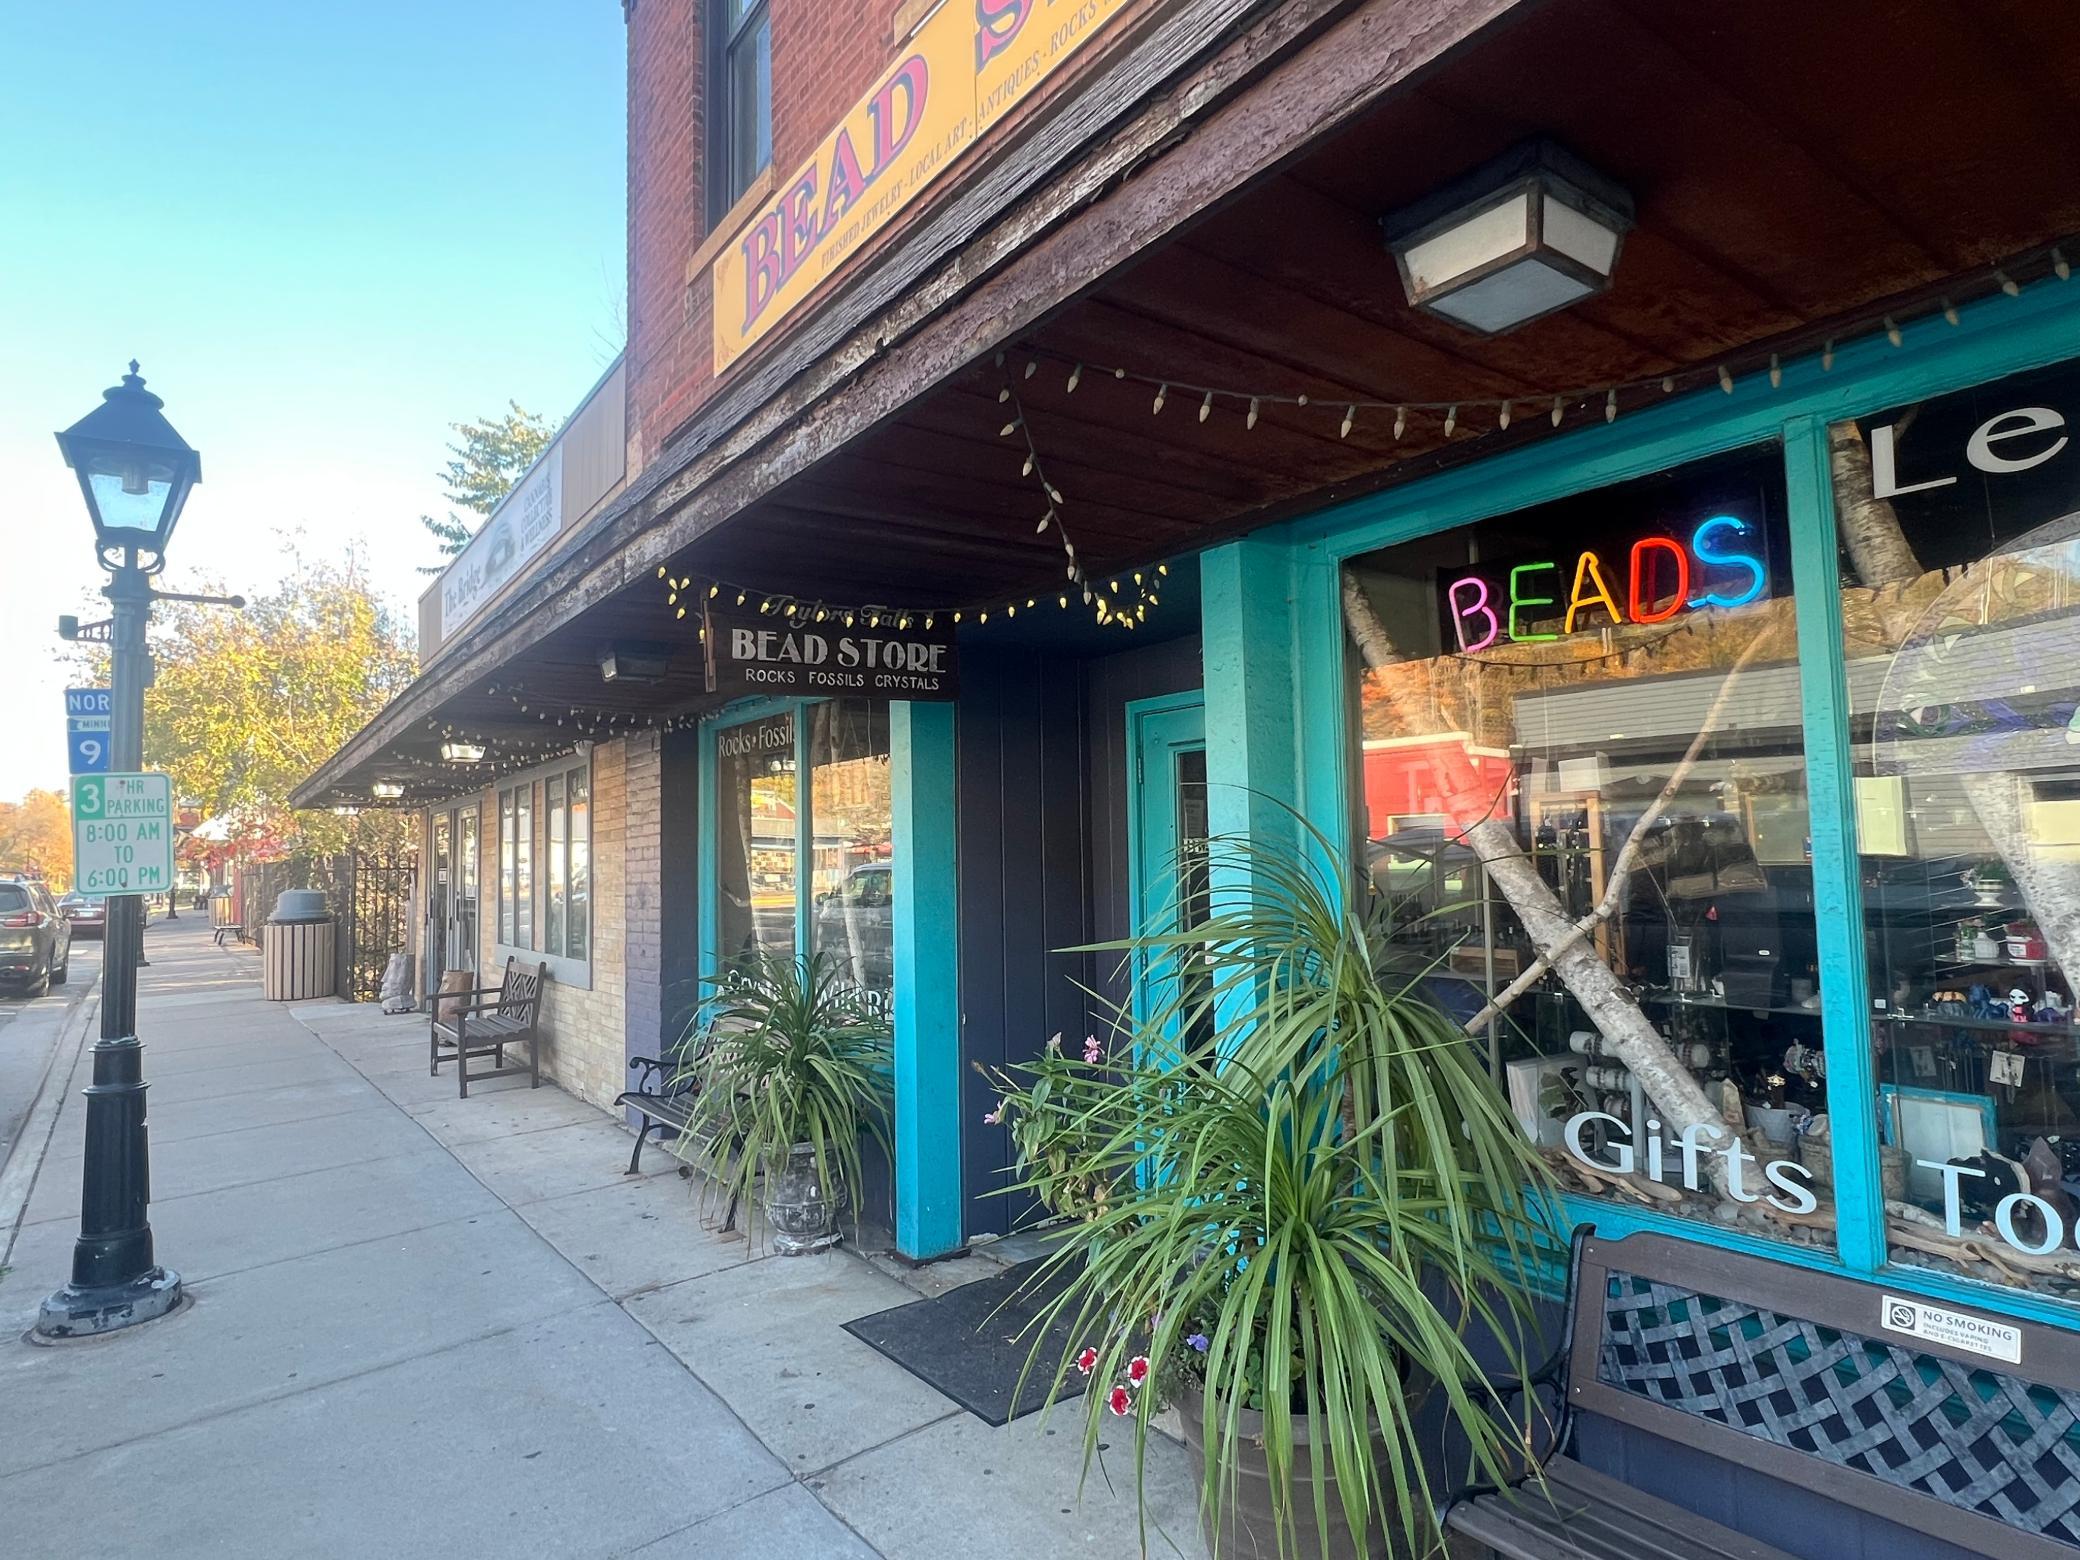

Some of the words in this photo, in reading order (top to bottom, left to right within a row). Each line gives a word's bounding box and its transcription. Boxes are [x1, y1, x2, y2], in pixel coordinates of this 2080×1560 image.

[861, 182, 902, 233] JEWELRY
[909, 143, 942, 187] LOCAL
[946, 117, 968, 154] ART
[978, 50, 1040, 118] ANTIQUES
[1050, 0, 1097, 57] ROCKS
[741, 54, 929, 337] BEAD
[1448, 515, 1767, 653] BEADS
[764, 594, 857, 629] Tylors
[732, 629, 828, 665] BEAD
[837, 638, 947, 673] STORE
[746, 668, 796, 684] ROCKS
[809, 671, 864, 687] FOSSILS
[875, 674, 940, 690] CRYSTALS
[69, 694, 110, 711] NOR
[719, 728, 751, 758] Rocks
[759, 715, 796, 749] Fossil
[80, 740, 101, 765] 9
[81, 784, 100, 813] 3
[126, 780, 144, 794] HR
[107, 799, 165, 814] PARKING
[87, 824, 127, 843] 8:00
[137, 823, 160, 841] AM
[115, 846, 133, 863] TO
[88, 868, 128, 887] 6:00
[138, 867, 160, 884] PM
[1564, 1111, 1817, 1214] Gifts
[1916, 1159, 2080, 1255] To
[1923, 1311, 1943, 1322] NO
[1946, 1316, 2012, 1341] SMOKING
